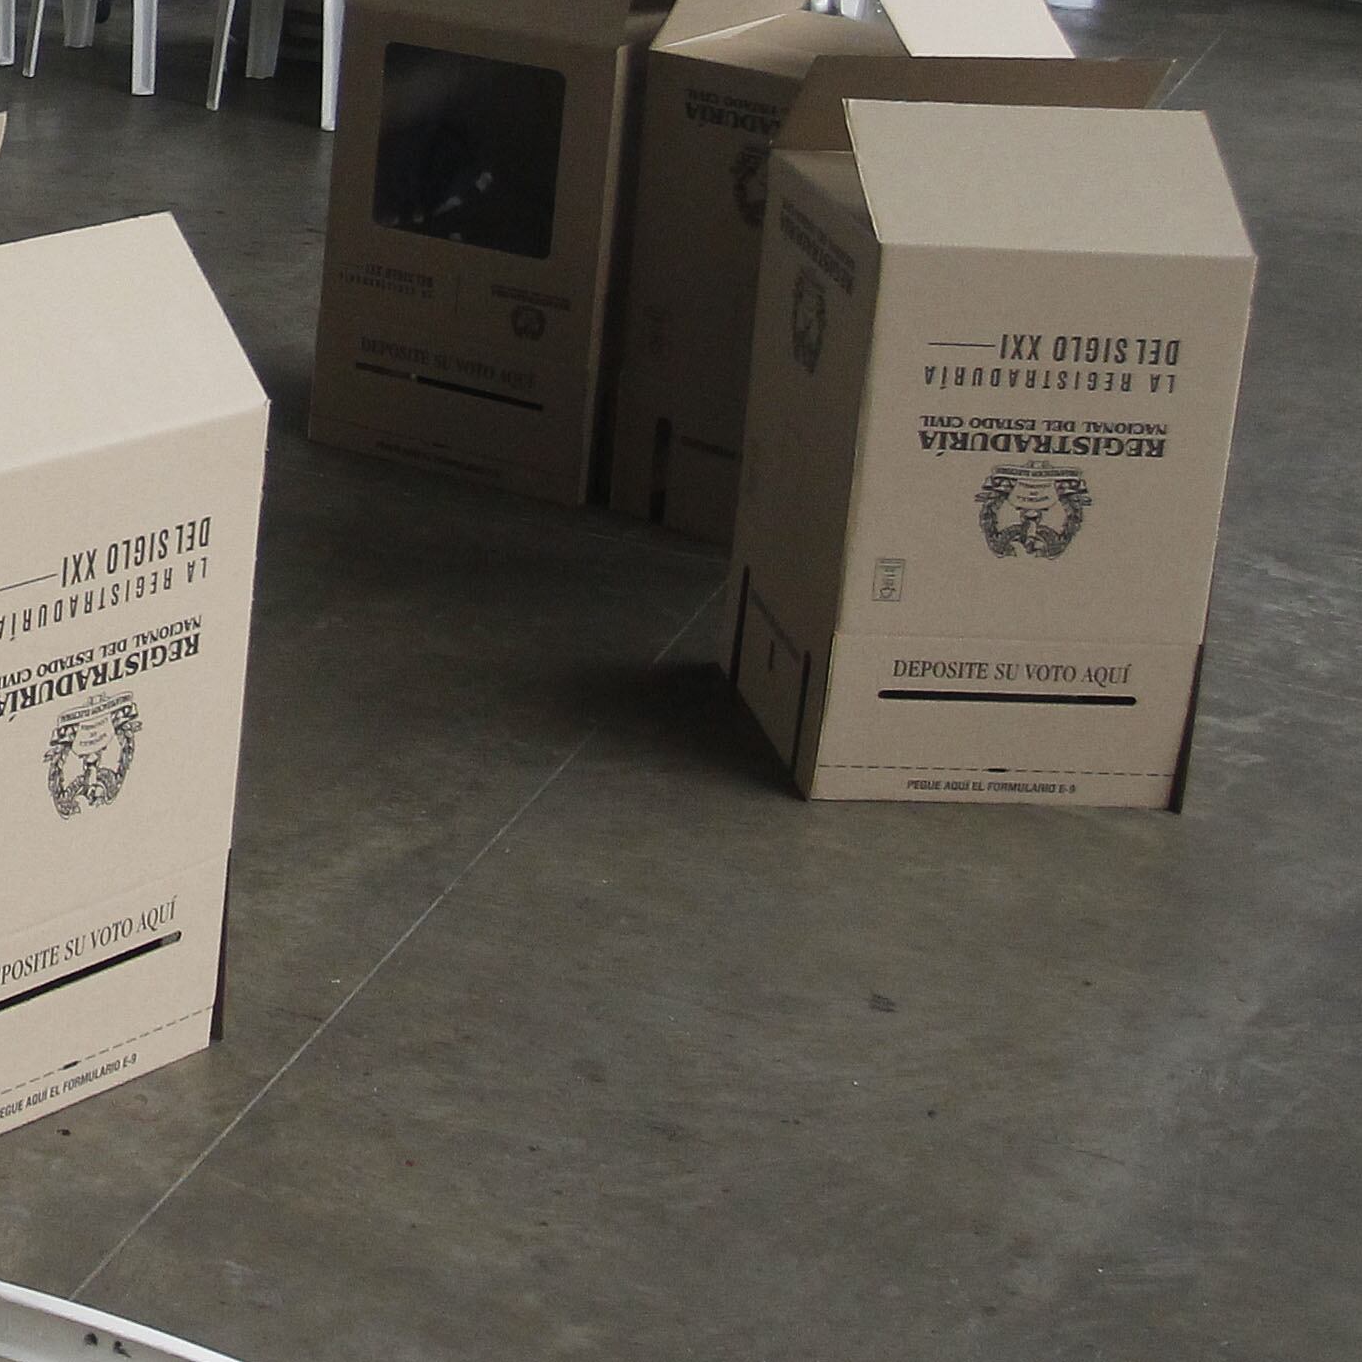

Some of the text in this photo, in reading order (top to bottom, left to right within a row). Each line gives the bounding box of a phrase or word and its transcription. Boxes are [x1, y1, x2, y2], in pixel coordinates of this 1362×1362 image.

[999, 333, 1042, 361] XXI
[924, 365, 1176, 394] LA REGISTRADURÍA
[919, 414, 1168, 435] NACIONAL DEL ESTADO CIVIL
[917, 430, 1166, 458] REGISTRADURÍA
[61, 516, 212, 588] DEL SIGLO XXI
[187, 557, 209, 583] LA
[132, 614, 203, 648] NACIONAL
[36, 648, 95, 678] ESTADO
[99, 638, 128, 659] DEL
[892, 659, 1133, 688] DEPOSITE SU VOTO AQUÍ
[907, 779, 943, 791] PEGUE
[971, 780, 985, 791] EL
[63, 934, 87, 961] SU
[89, 917, 134, 951] VOTO
[135, 894, 178, 933] AQUÍ
[49, 1085, 62, 1099] EL
[62, 1058, 122, 1095] FORMULARIO
[121, 1052, 138, 1070] E-9
